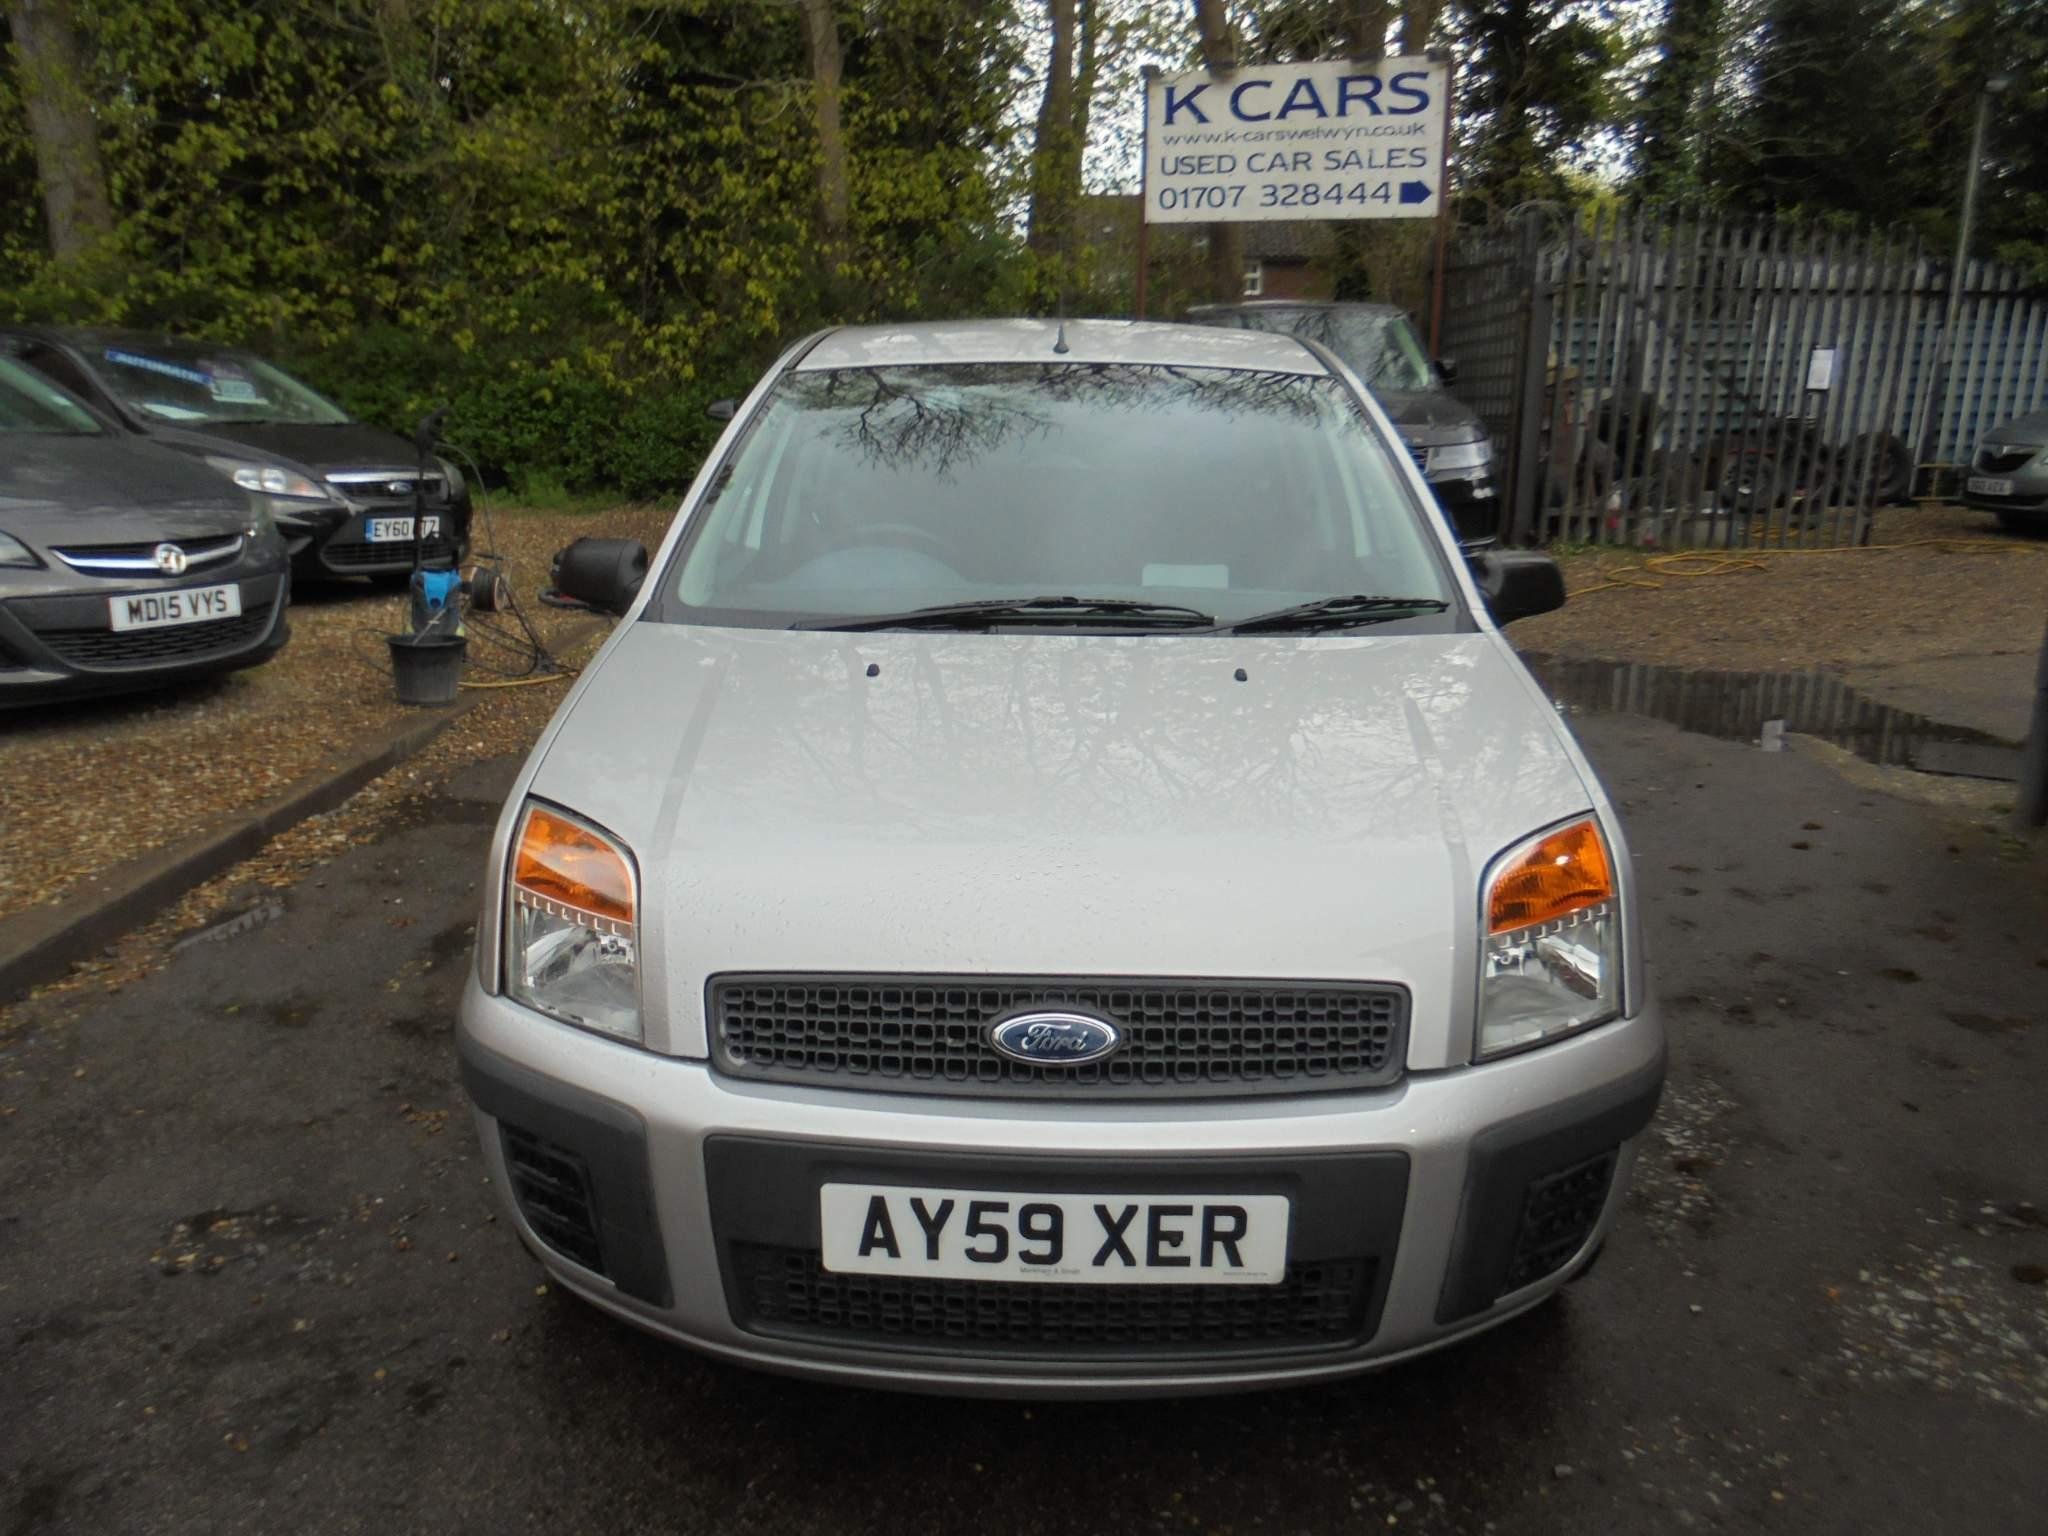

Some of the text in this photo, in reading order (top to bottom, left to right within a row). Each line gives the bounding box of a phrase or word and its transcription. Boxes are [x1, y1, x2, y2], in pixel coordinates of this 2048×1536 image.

[1163, 71, 1430, 125] K CARS
[1160, 147, 1427, 176] USED CAR SALES
[1159, 181, 1392, 209] 01707 328444
[374, 521, 410, 537] EY60
[127, 590, 228, 623] MD15 VYS
[1021, 1022, 1088, 1050] Ford
[858, 1195, 1248, 1267] AY59 XER
